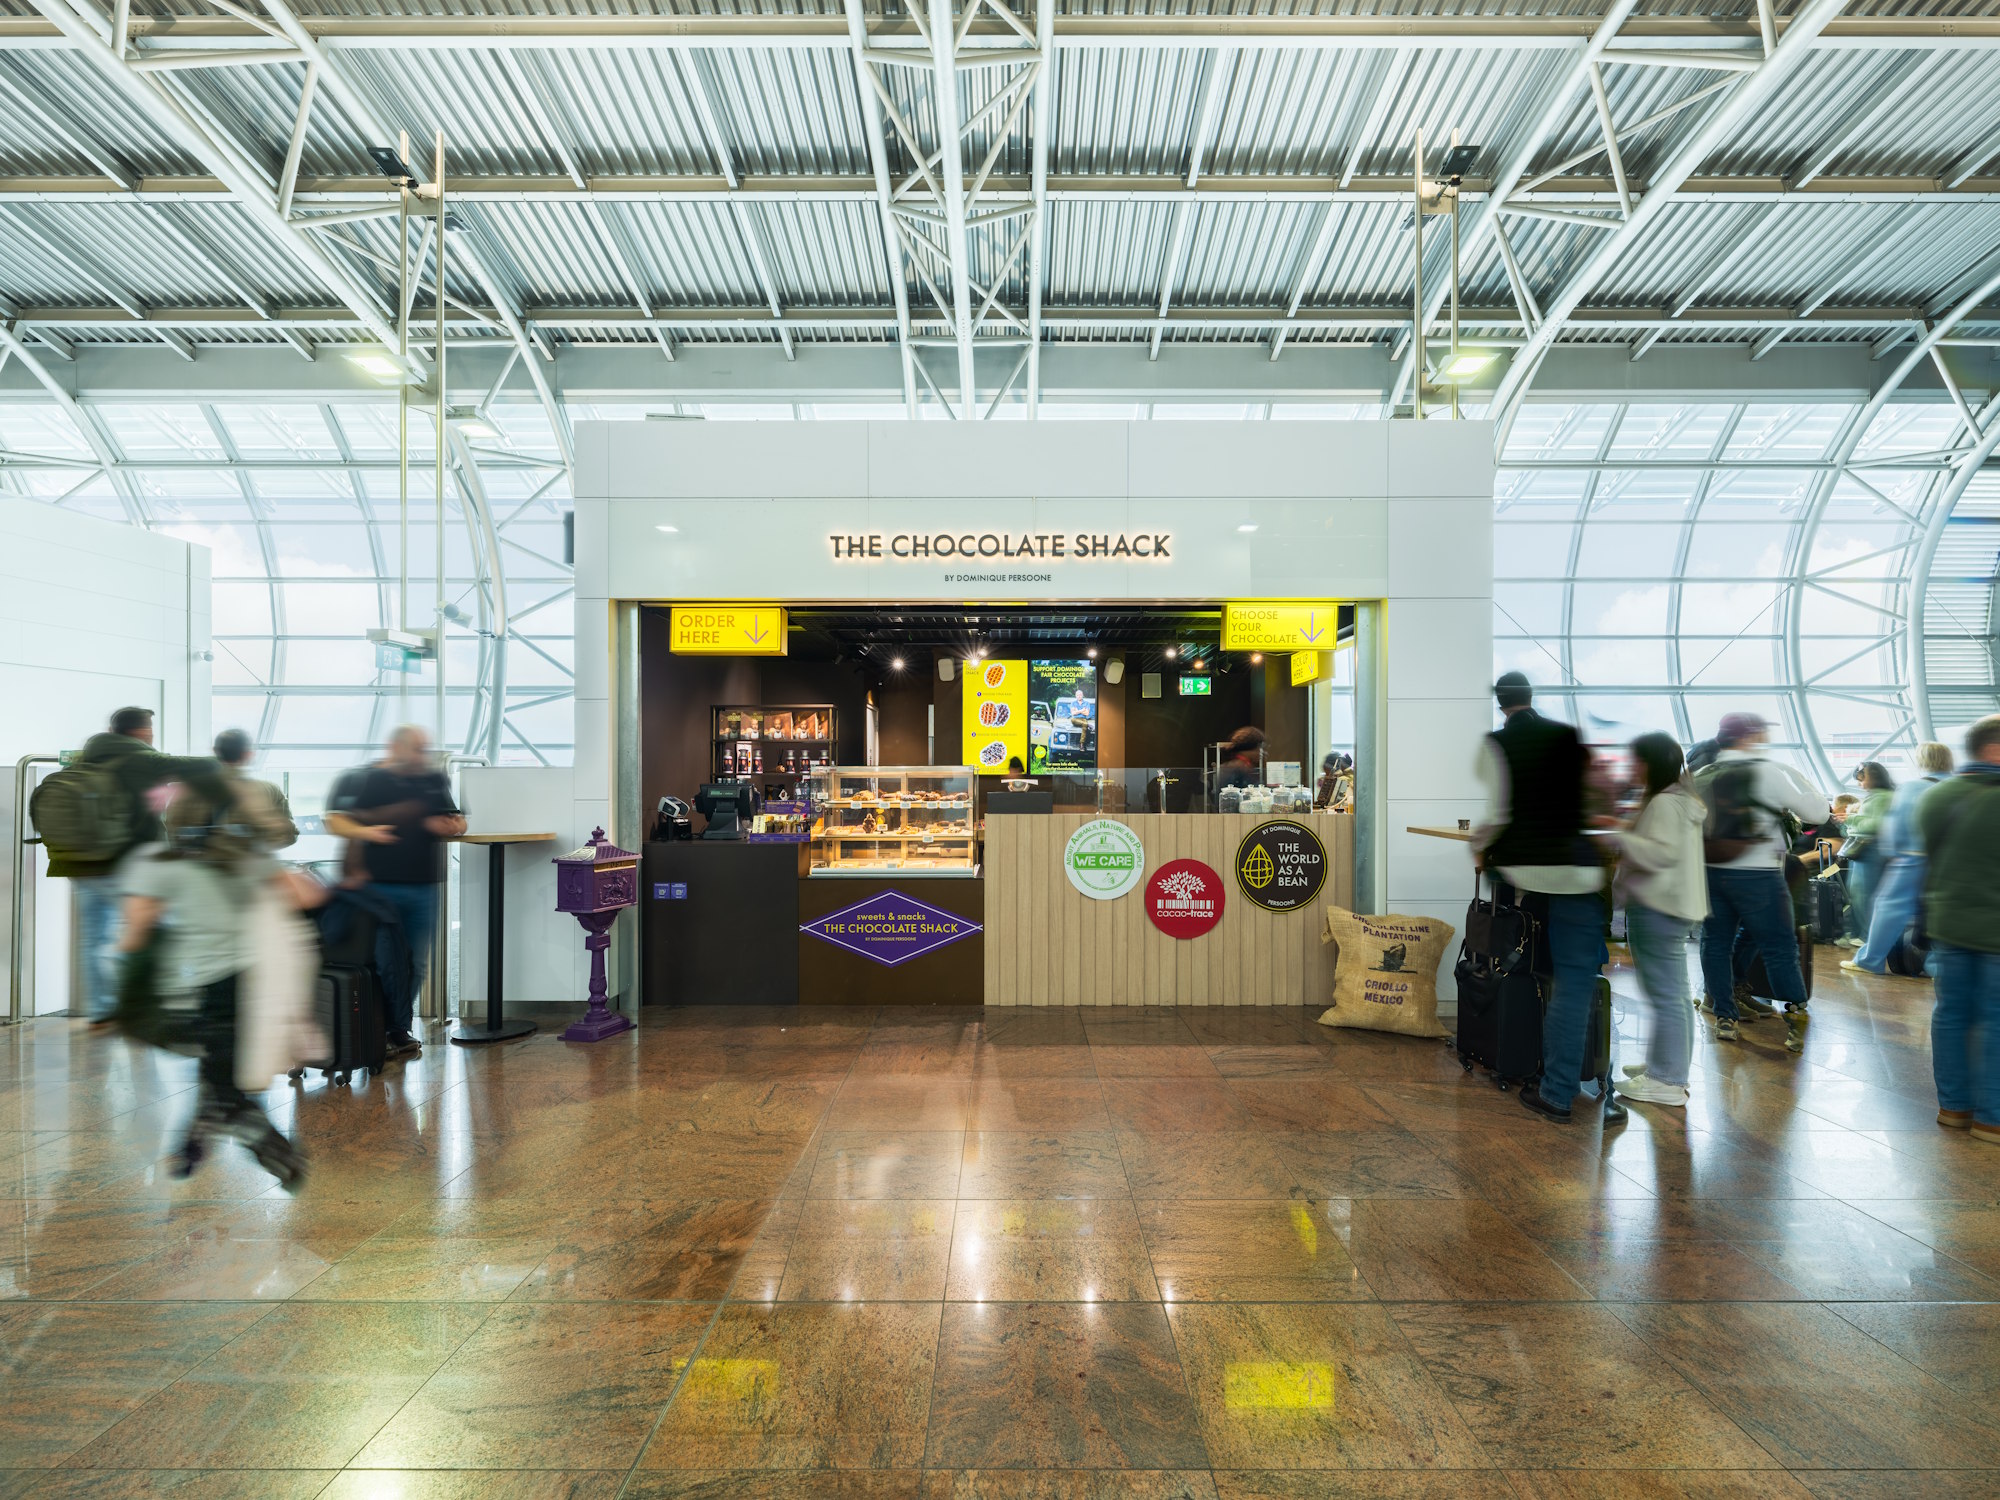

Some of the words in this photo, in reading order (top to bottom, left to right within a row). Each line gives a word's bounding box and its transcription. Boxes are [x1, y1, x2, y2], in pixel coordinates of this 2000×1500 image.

[830, 534, 882, 558] THE
[891, 534, 1065, 558] CHOCOLATE
[1073, 534, 1171, 558] SHACK
[944, 574, 955, 582] BY
[956, 574, 1006, 583] DOMINIQUE
[1008, 574, 1052, 582] PERSOONE
[1231, 610, 1279, 620] CHOOSE
[679, 614, 736, 628] ORDER
[1231, 622, 1262, 632] YOUR
[679, 631, 720, 644] HERE
[1230, 634, 1298, 644] CHOCOLATE
[1269, 825, 1301, 836] DOMINIQUE
[1277, 842, 1300, 853] THE
[1066, 845, 1074, 866] ABOUT
[1075, 855, 1097, 867] WE
[1098, 855, 1132, 867] CARE
[1277, 854, 1320, 864] WORLD
[1277, 865, 1293, 875] AS
[1294, 865, 1304, 875] A
[1278, 876, 1308, 887] BEAN
[1267, 899, 1296, 907] PERSOONE
[856, 912, 886, 921] sweets
[888, 911, 895, 921] &
[897, 911, 926, 921] snacks
[1156, 909, 1214, 918] cacao-trace
[824, 923, 845, 933] THE
[847, 923, 918, 934] CHOCOLATE
[920, 923, 959, 934] SHACK
[1363, 925, 1421, 942] PLANTATION
[1409, 925, 1431, 933] LINE
[1364, 979, 1409, 992] CRIOLLO
